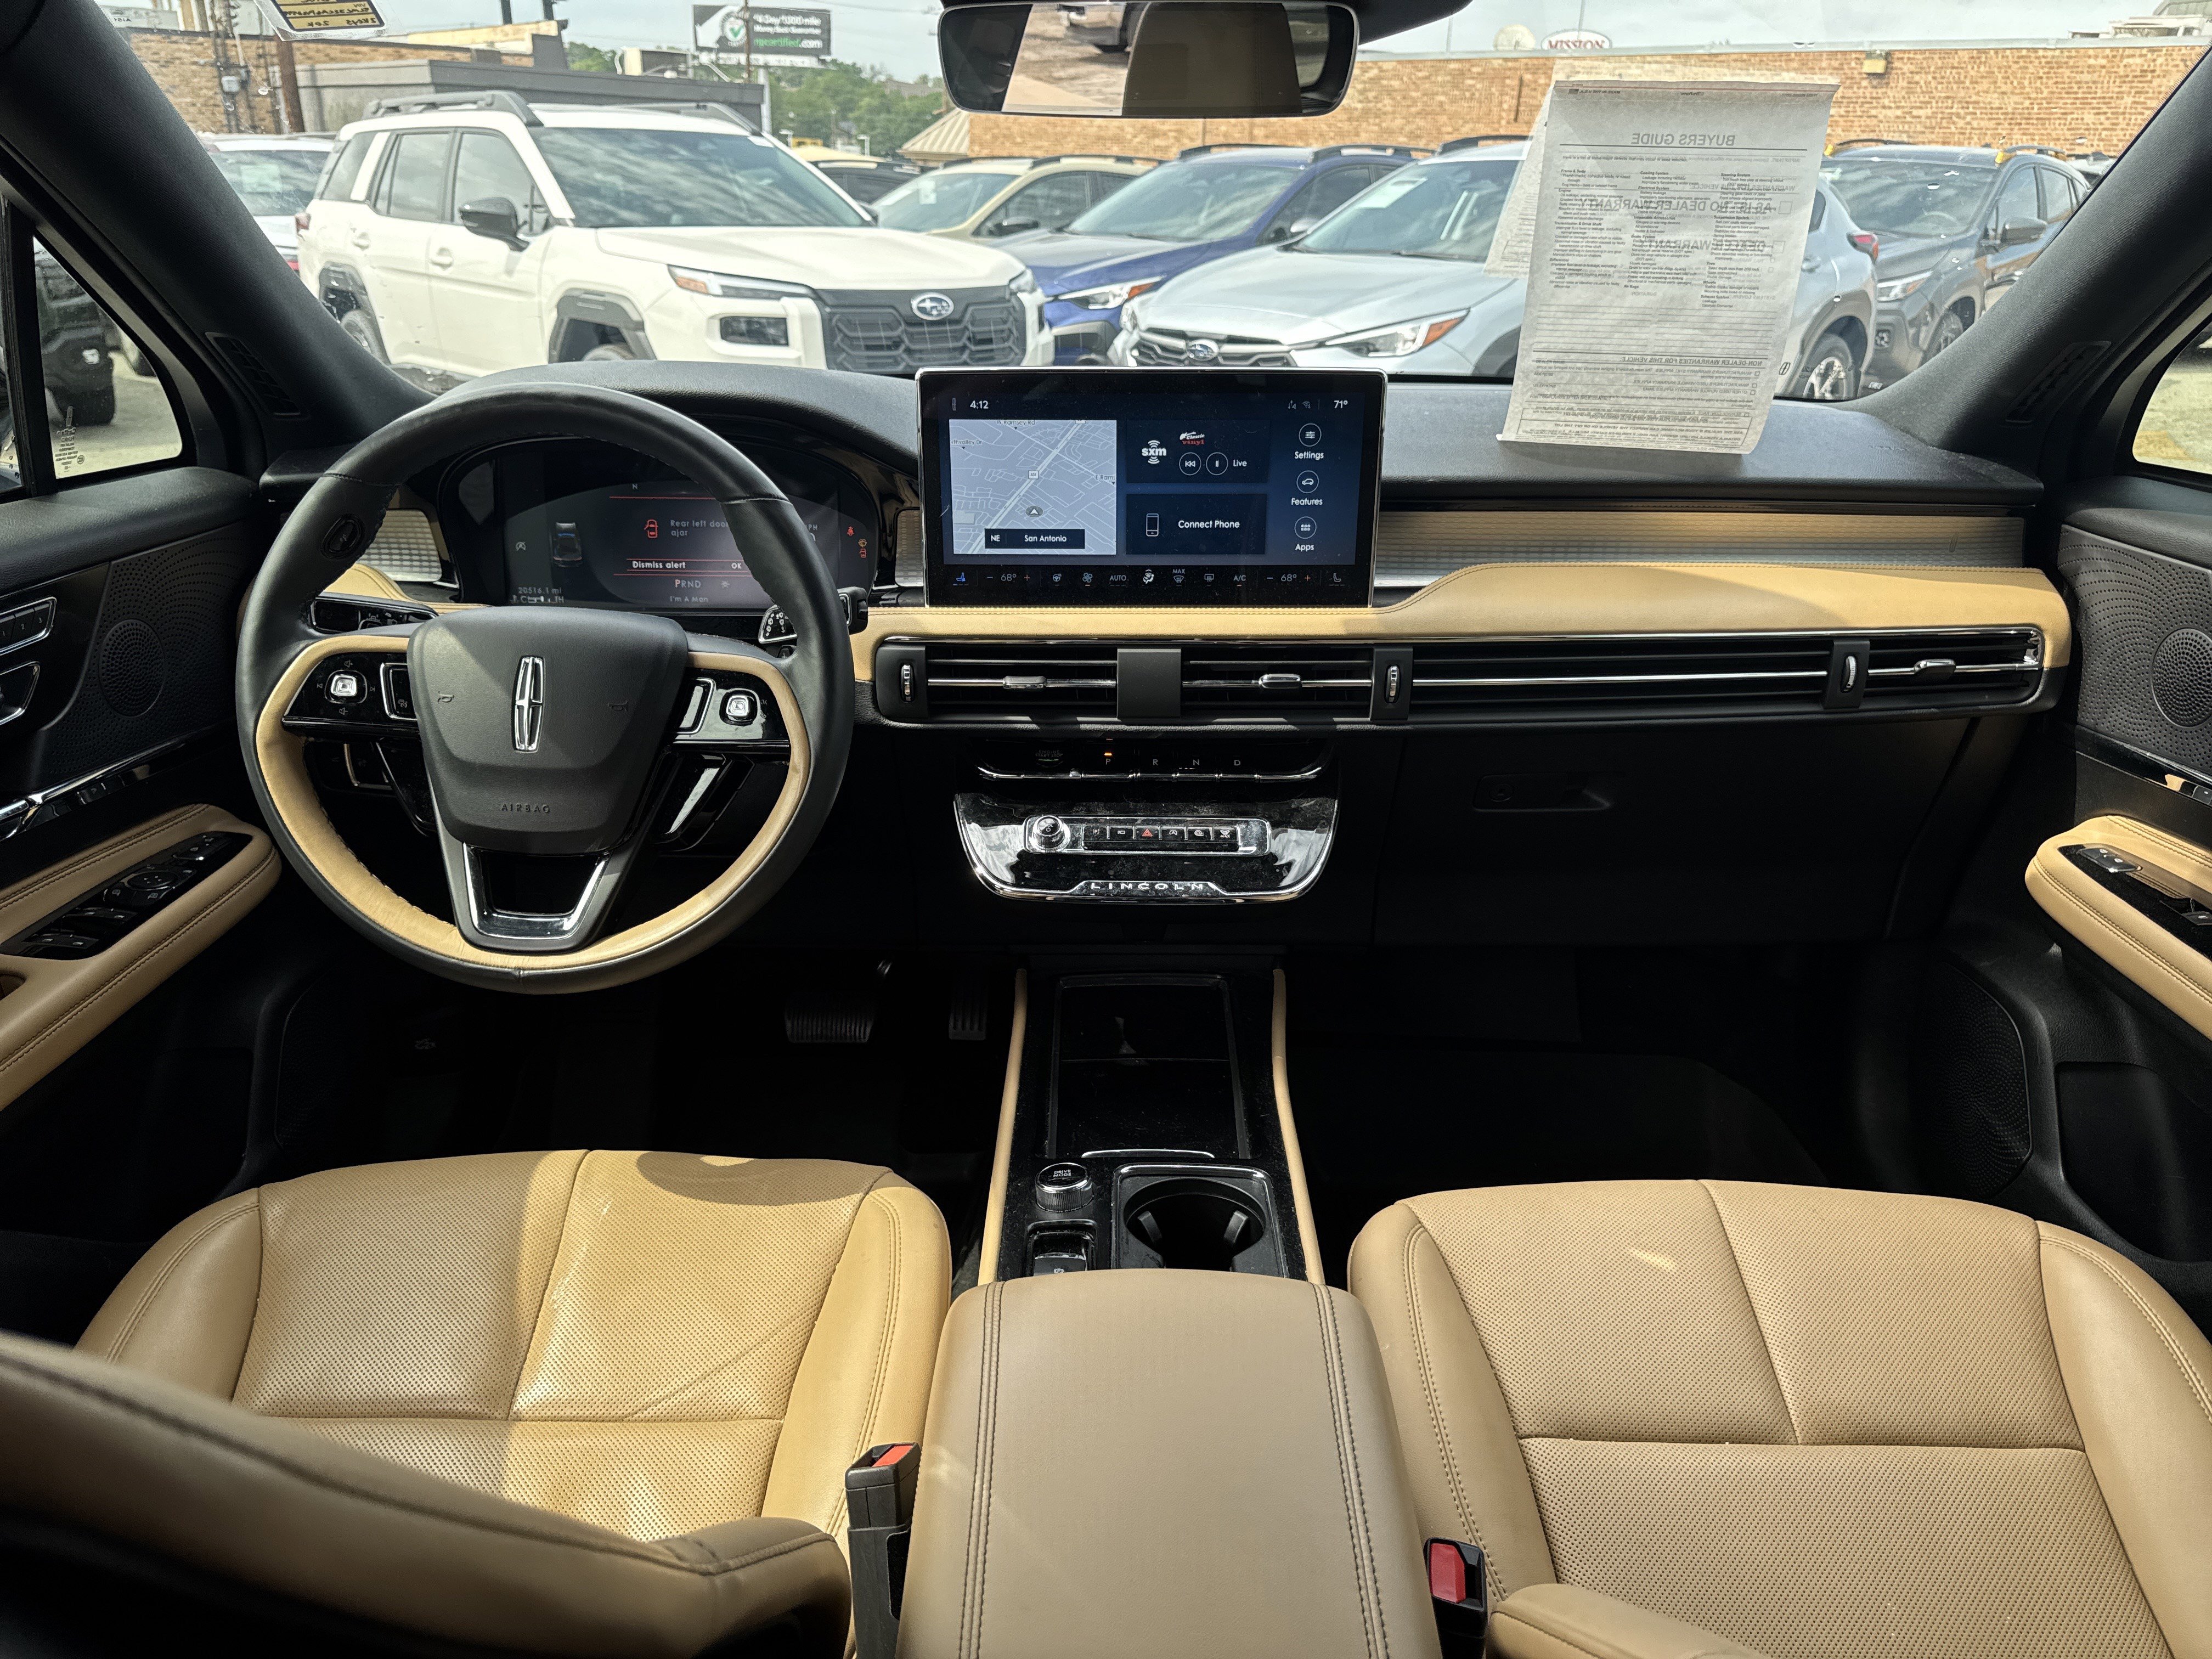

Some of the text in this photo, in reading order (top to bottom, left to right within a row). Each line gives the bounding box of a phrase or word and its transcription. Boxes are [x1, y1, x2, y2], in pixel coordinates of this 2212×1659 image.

[969, 400, 989, 409] 4:12
[1141, 447, 1167, 456] sxm
[1294, 451, 1324, 460] Settings
[1232, 459, 1247, 467] Live
[1291, 498, 1323, 506] Features
[670, 520, 690, 528] Rear
[692, 520, 707, 528] left
[1178, 520, 1240, 529] Connect Phone
[670, 529, 689, 538] ajar
[1295, 543, 1314, 552] Apps
[631, 560, 686, 569] Dismiss alert
[551, 586, 562, 594] mi
[500, 802, 550, 814] AIRBAG
[1091, 882, 1203, 891] LINCOLN
